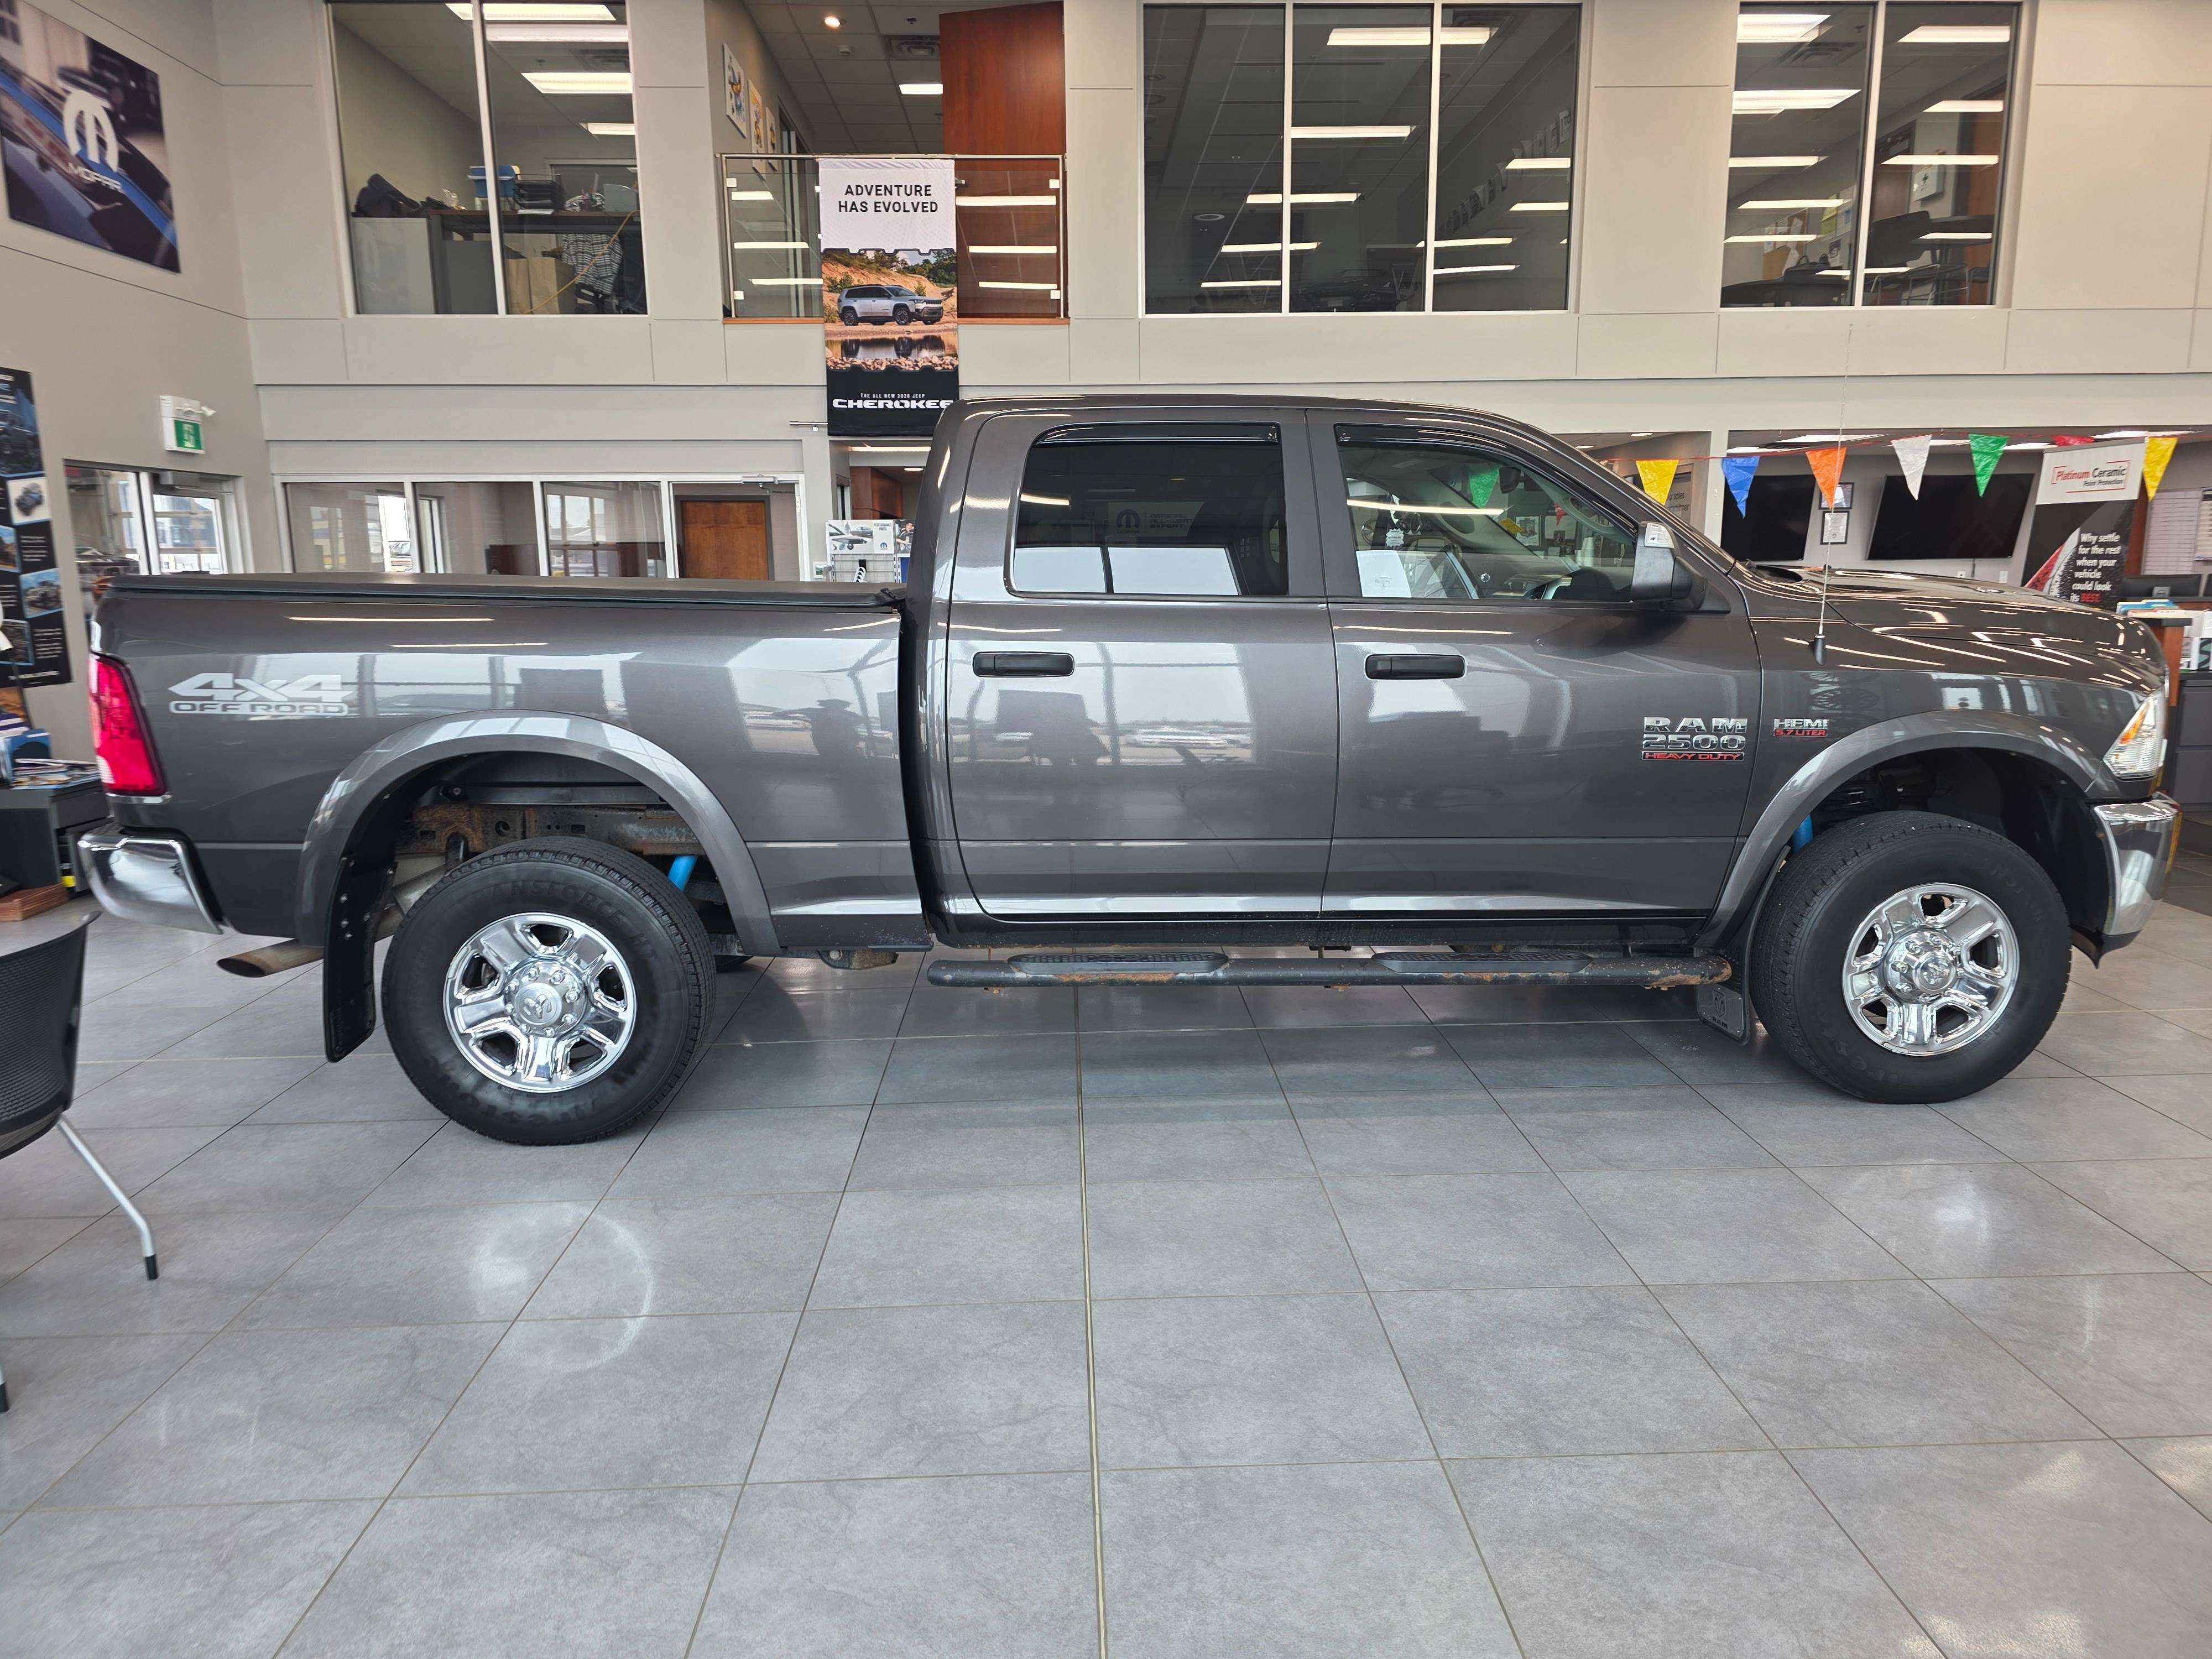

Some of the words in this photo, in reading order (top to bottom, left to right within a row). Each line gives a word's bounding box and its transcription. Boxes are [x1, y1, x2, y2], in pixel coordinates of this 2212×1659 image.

[66, 162, 123, 193] MOPAR
[844, 185, 932, 196] ADVENTURE
[838, 201, 868, 212] HAS
[874, 201, 938, 212] EVOLVED
[832, 399, 953, 409] CHEROKEE
[2056, 470, 2090, 481] Platinum
[2092, 466, 2127, 478] Ceramic
[2081, 533, 2099, 544] Why
[2098, 532, 2120, 542] settle
[2078, 545, 2091, 554] for
[2091, 545, 2105, 554] the
[2105, 546, 2121, 554] rest
[2076, 557, 2098, 566] when
[2098, 560, 2117, 568] your
[2074, 569, 2102, 578] vehicle
[2072, 581, 2094, 591] could
[2094, 581, 2112, 591] look
[174, 703, 242, 712] OFF
[250, 703, 345, 713] ROAD
[1644, 717, 1748, 733] RAM
[1774, 718, 1828, 729] HEMI
[1642, 734, 1746, 750] 2500
[1645, 752, 1697, 760] HEAVY
[1698, 752, 1741, 760] DUTY
